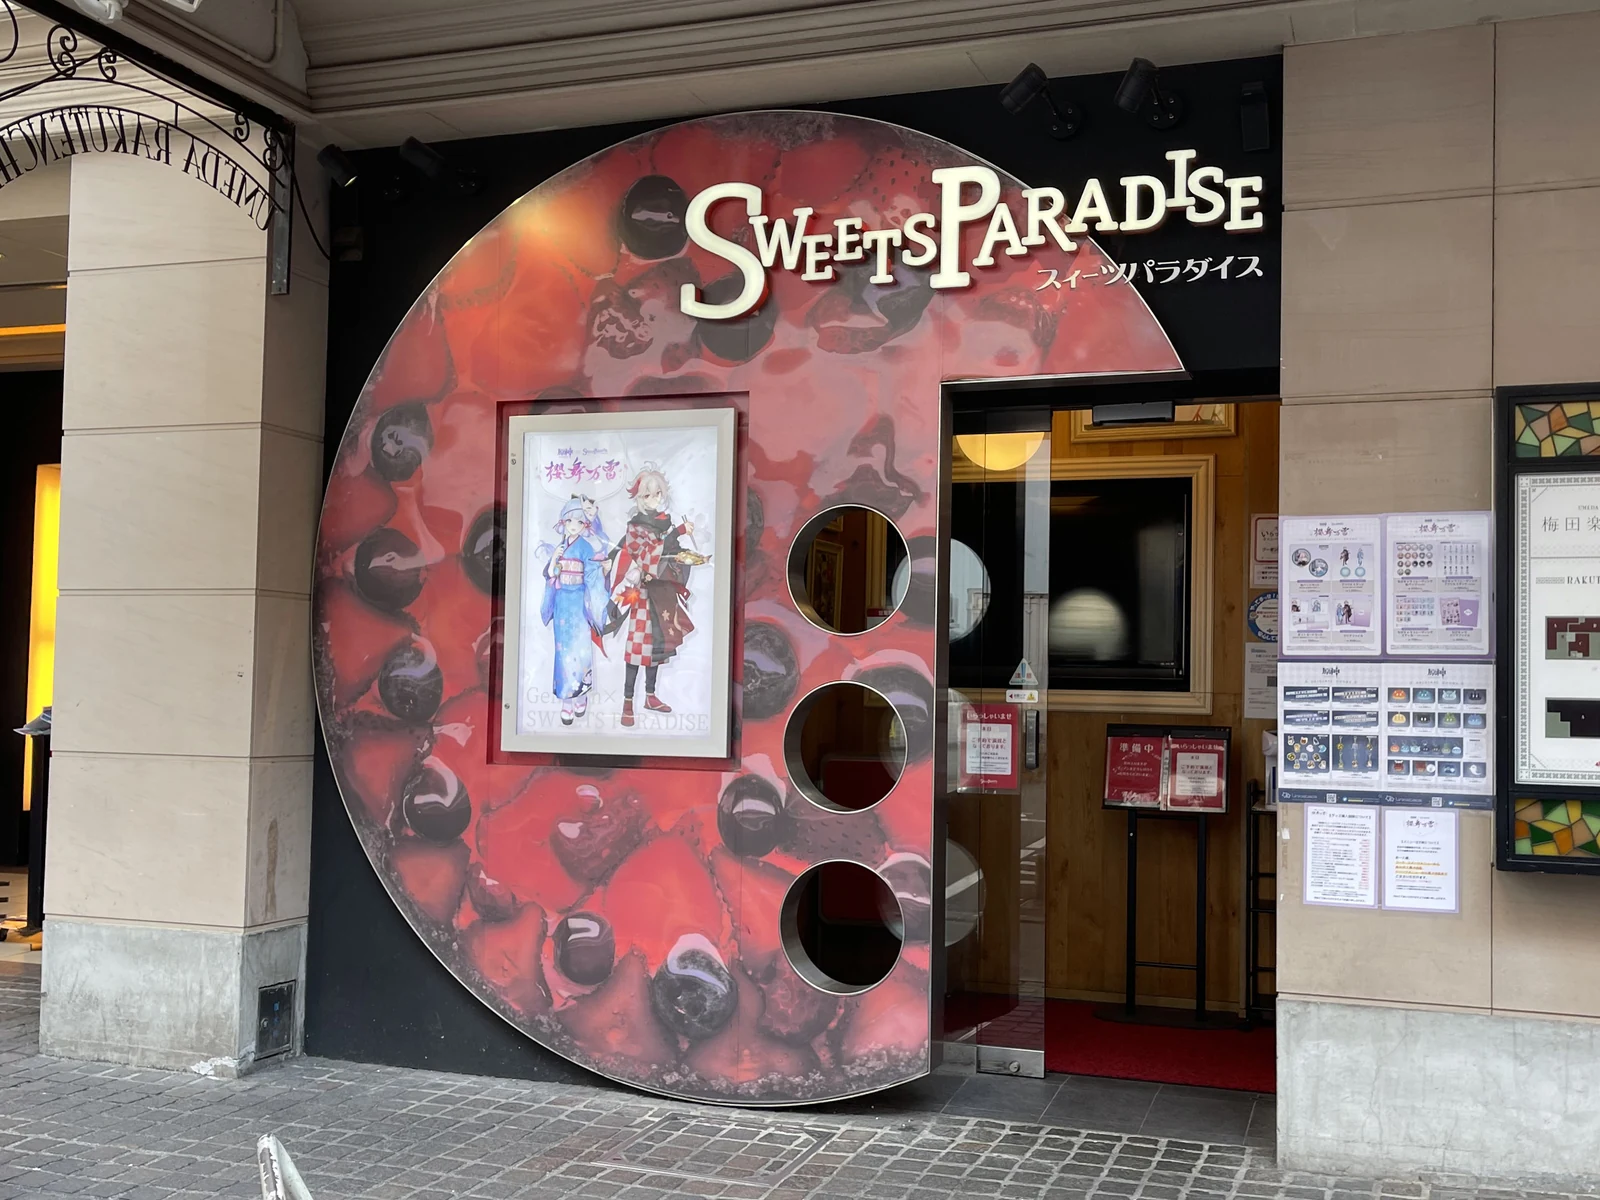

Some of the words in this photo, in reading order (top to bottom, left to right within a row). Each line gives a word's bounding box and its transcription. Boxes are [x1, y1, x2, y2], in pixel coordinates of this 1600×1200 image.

[526, 710, 606, 730] SWTS
[612, 712, 709, 732] PRADISE
[1119, 742, 1154, 754] 準備中
